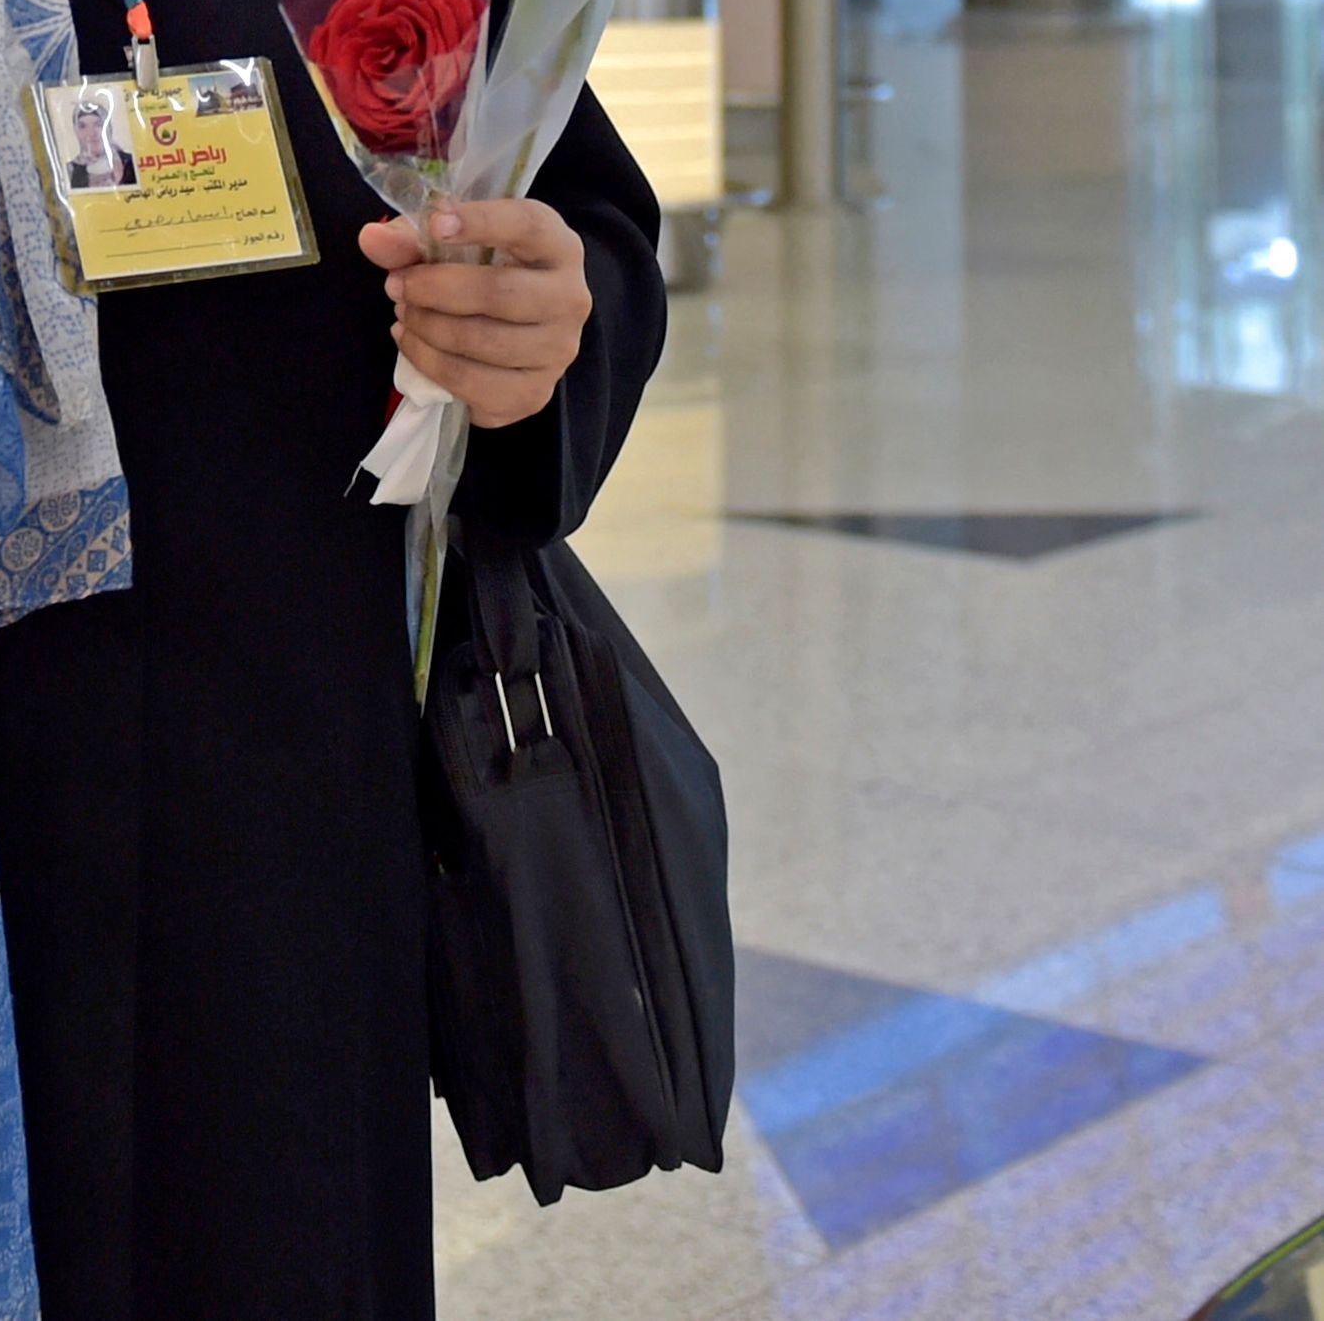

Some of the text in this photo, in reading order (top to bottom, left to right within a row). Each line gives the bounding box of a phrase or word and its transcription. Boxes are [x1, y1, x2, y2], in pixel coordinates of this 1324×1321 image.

[137, 144, 227, 172] رياض الحرمي
[157, 184, 178, 199] رياض
